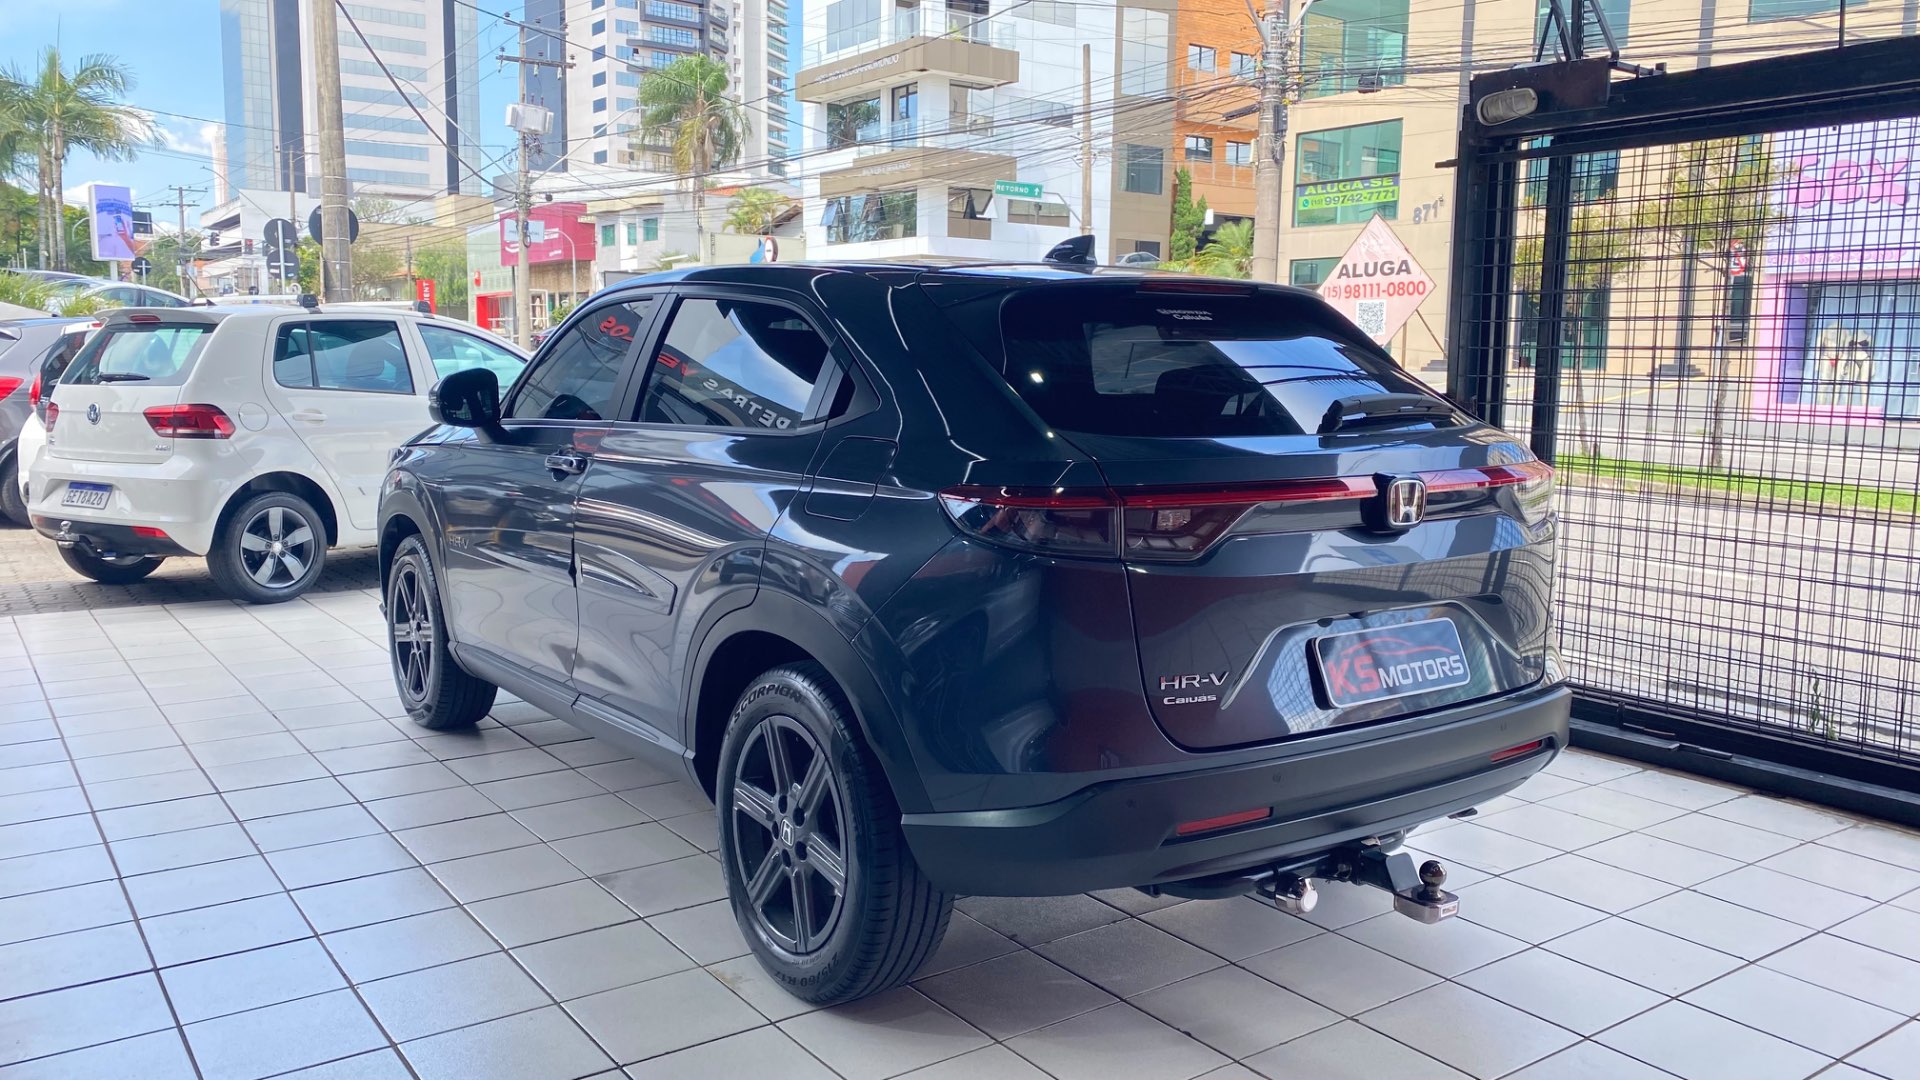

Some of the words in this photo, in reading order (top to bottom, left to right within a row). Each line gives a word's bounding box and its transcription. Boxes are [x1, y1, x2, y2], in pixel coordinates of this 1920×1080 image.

[996, 184, 1029, 194] RETORNO
[1304, 176, 1395, 195] ALUGA-SE
[1324, 188, 1396, 206] 99742-7771
[1413, 199, 1438, 224] 871
[1337, 259, 1412, 279] ALUGA
[1323, 284, 1341, 300] (15)
[1344, 280, 1426, 299] 98111-0800
[65, 489, 105, 506] GET8A26
[1160, 672, 1229, 690] HR-V
[1378, 655, 1465, 689] MOTORS
[733, 684, 803, 723] SCORPION
